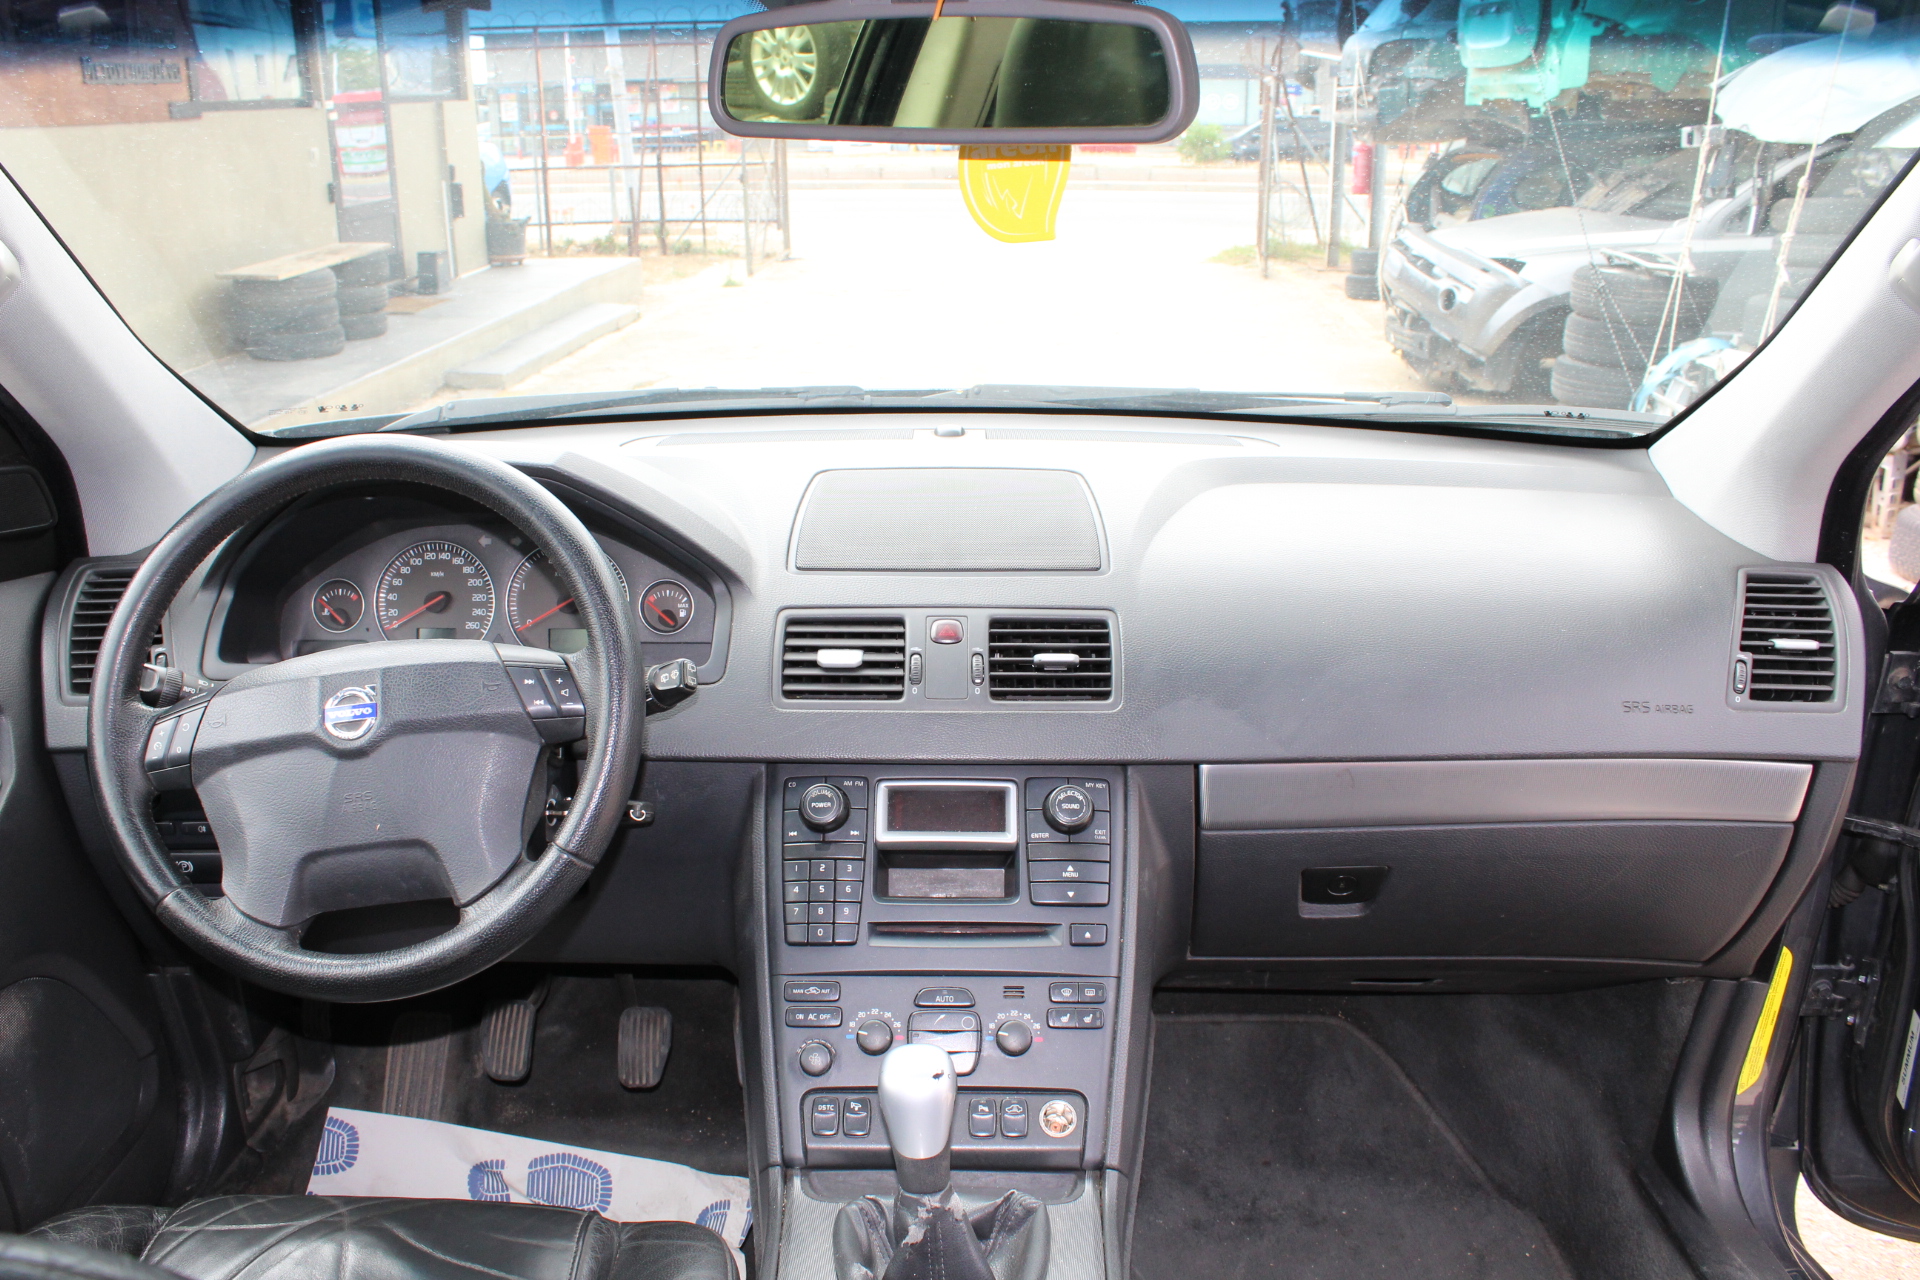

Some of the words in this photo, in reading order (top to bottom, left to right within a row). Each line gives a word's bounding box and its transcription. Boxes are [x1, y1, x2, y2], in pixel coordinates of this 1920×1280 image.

[424, 552, 437, 560] 120
[438, 552, 451, 560] 140
[410, 557, 423, 566] 100
[452, 557, 465, 565] 160
[400, 566, 411, 574] 80
[462, 566, 475, 574] 180
[392, 578, 403, 586] 60
[467, 578, 483, 587] 200
[387, 593, 398, 601] 40
[472, 593, 487, 602] 220
[388, 608, 399, 616] 20
[472, 608, 487, 616] 240
[465, 621, 480, 630] 260
[182, 686, 196, 694] INFO
[1622, 701, 1651, 714] SRS
[1655, 704, 1694, 714] AIRBAG
[327, 707, 373, 719] VOLVO
[1058, 790, 1084, 801] SELECTOR
[845, 885, 852, 893] 6
[818, 907, 824, 915] 8
[843, 907, 849, 915] 9
[935, 995, 954, 1003] AUTO
[1901, 1030, 1916, 1086] SUMMUM
